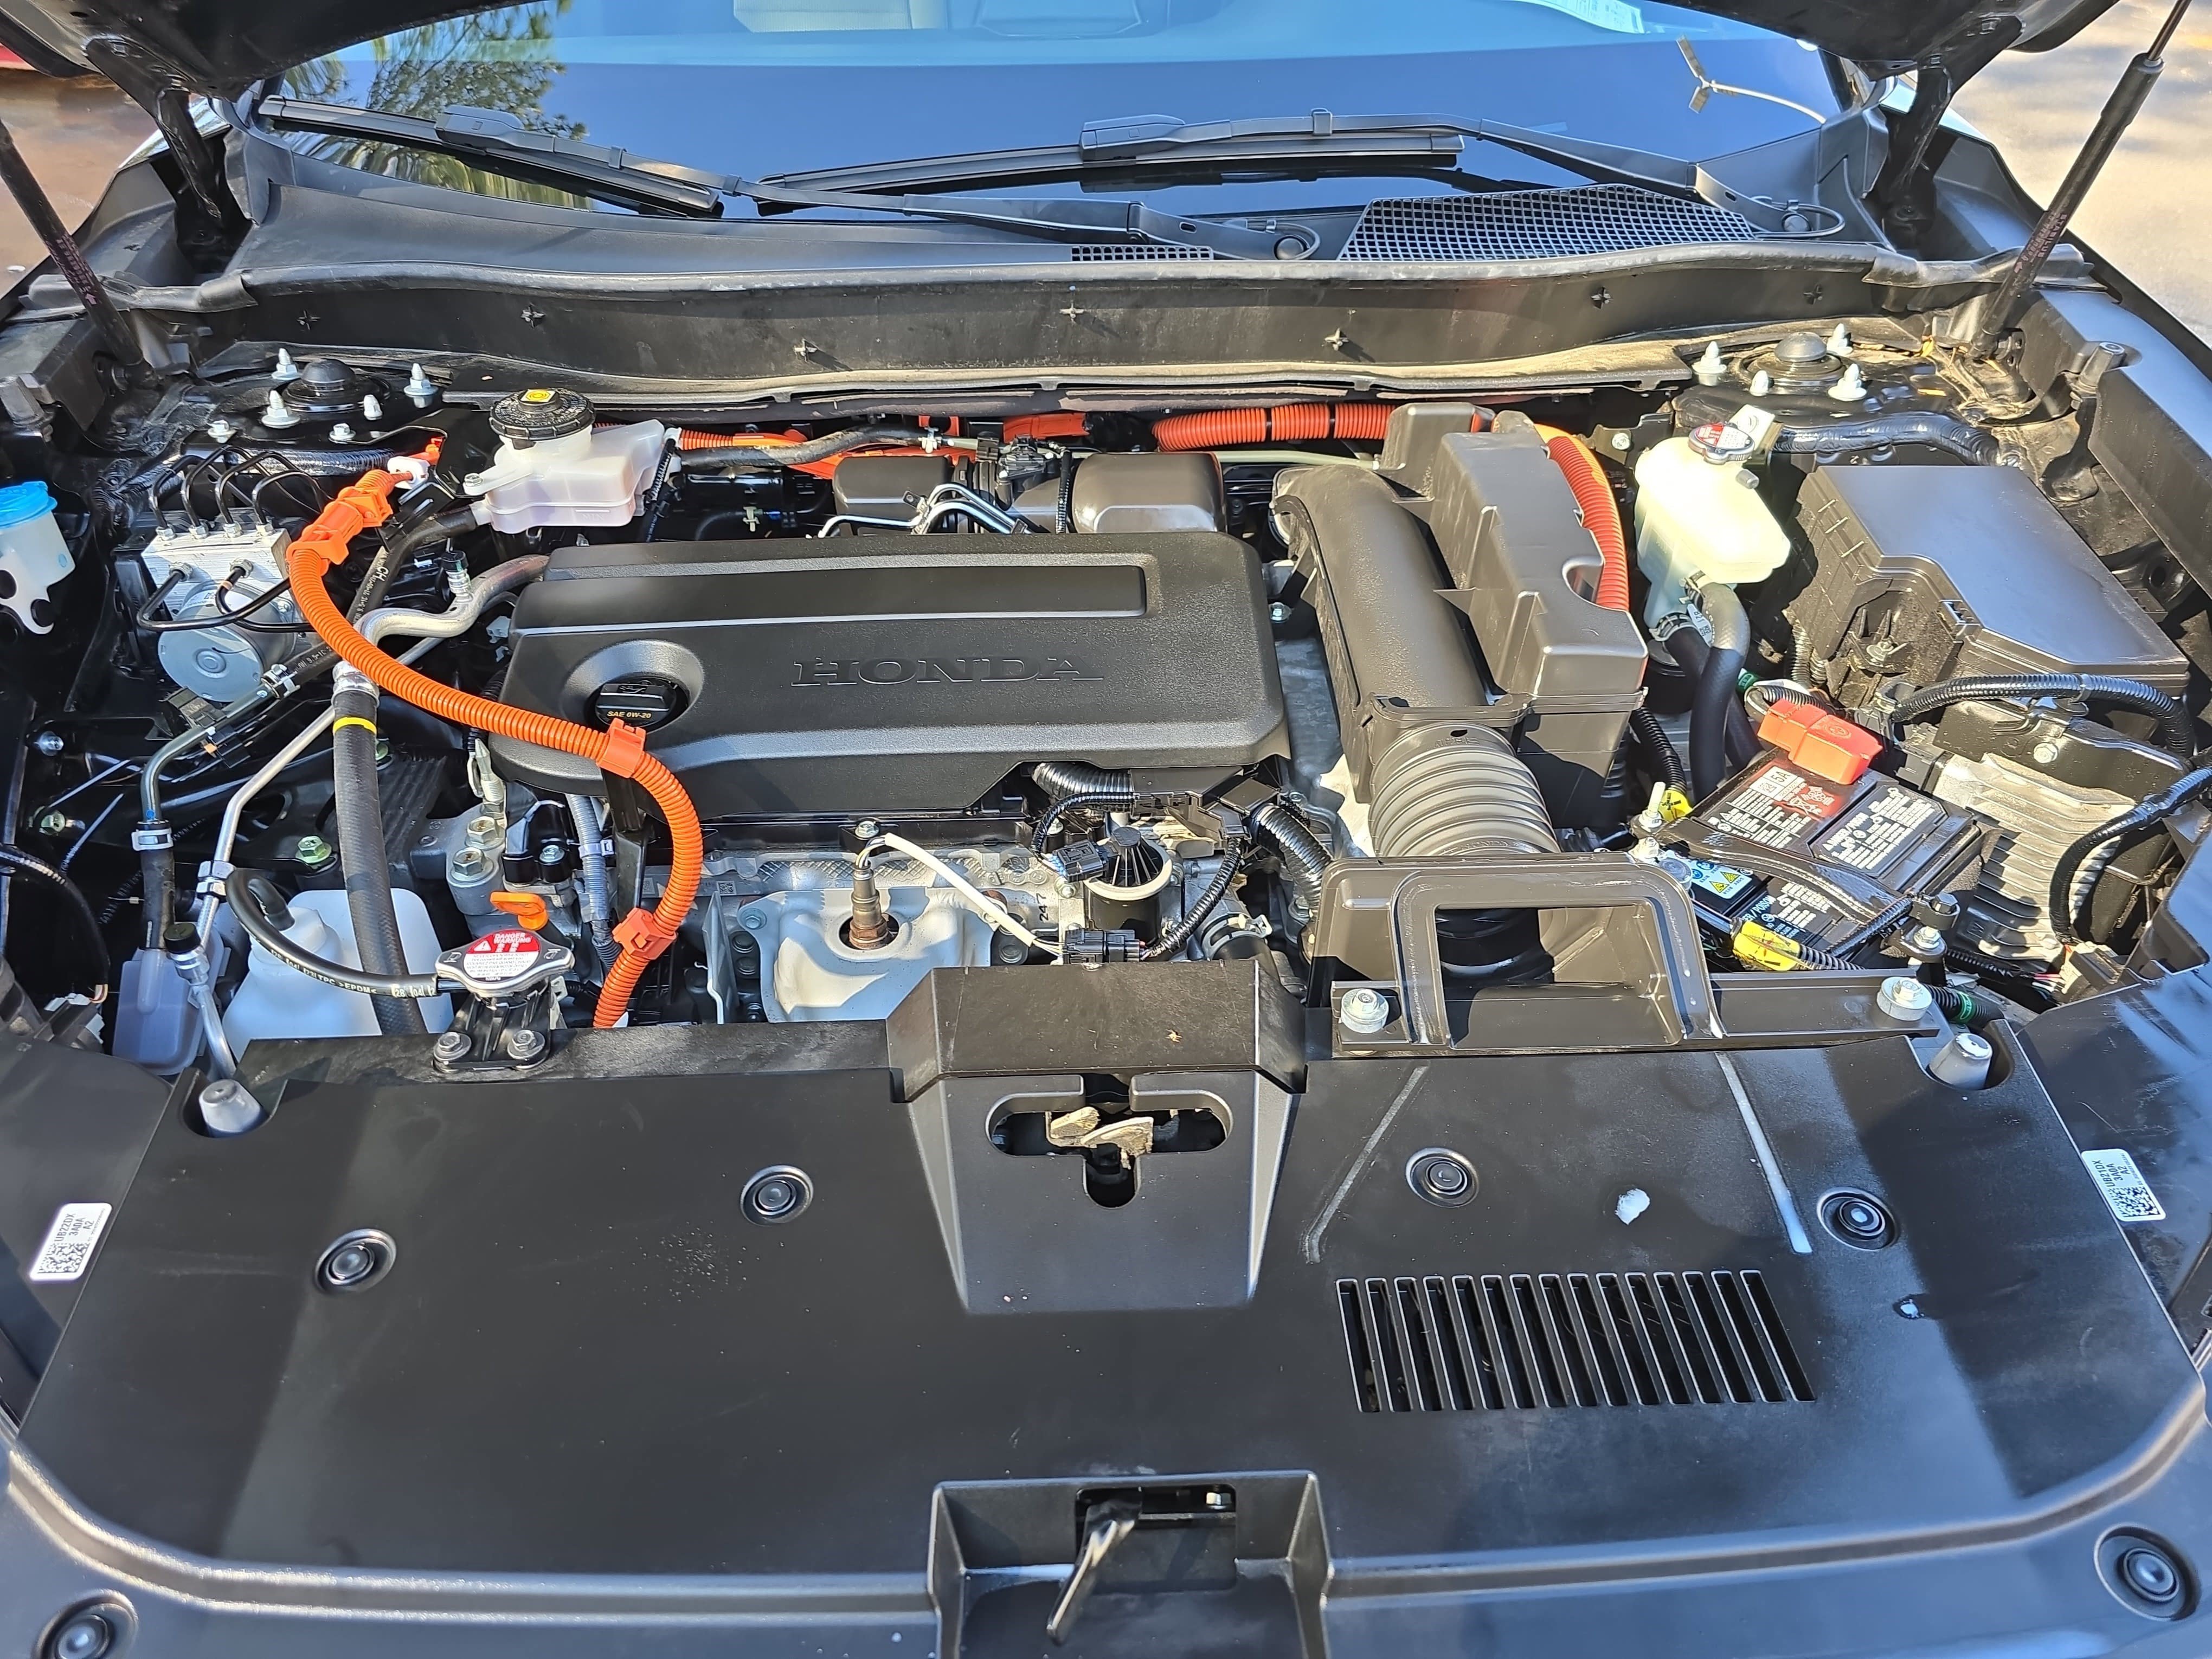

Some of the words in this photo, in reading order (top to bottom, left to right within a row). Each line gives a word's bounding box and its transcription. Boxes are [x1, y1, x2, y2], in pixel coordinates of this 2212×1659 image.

[790, 657, 1104, 686] HONDA
[1036, 893, 1049, 921] 247
[2092, 1160, 2115, 1187] UB21DX
[2117, 1166, 2130, 1174] A2
[54, 1213, 76, 1242] UB22DX
[82, 1220, 95, 1230] A2
